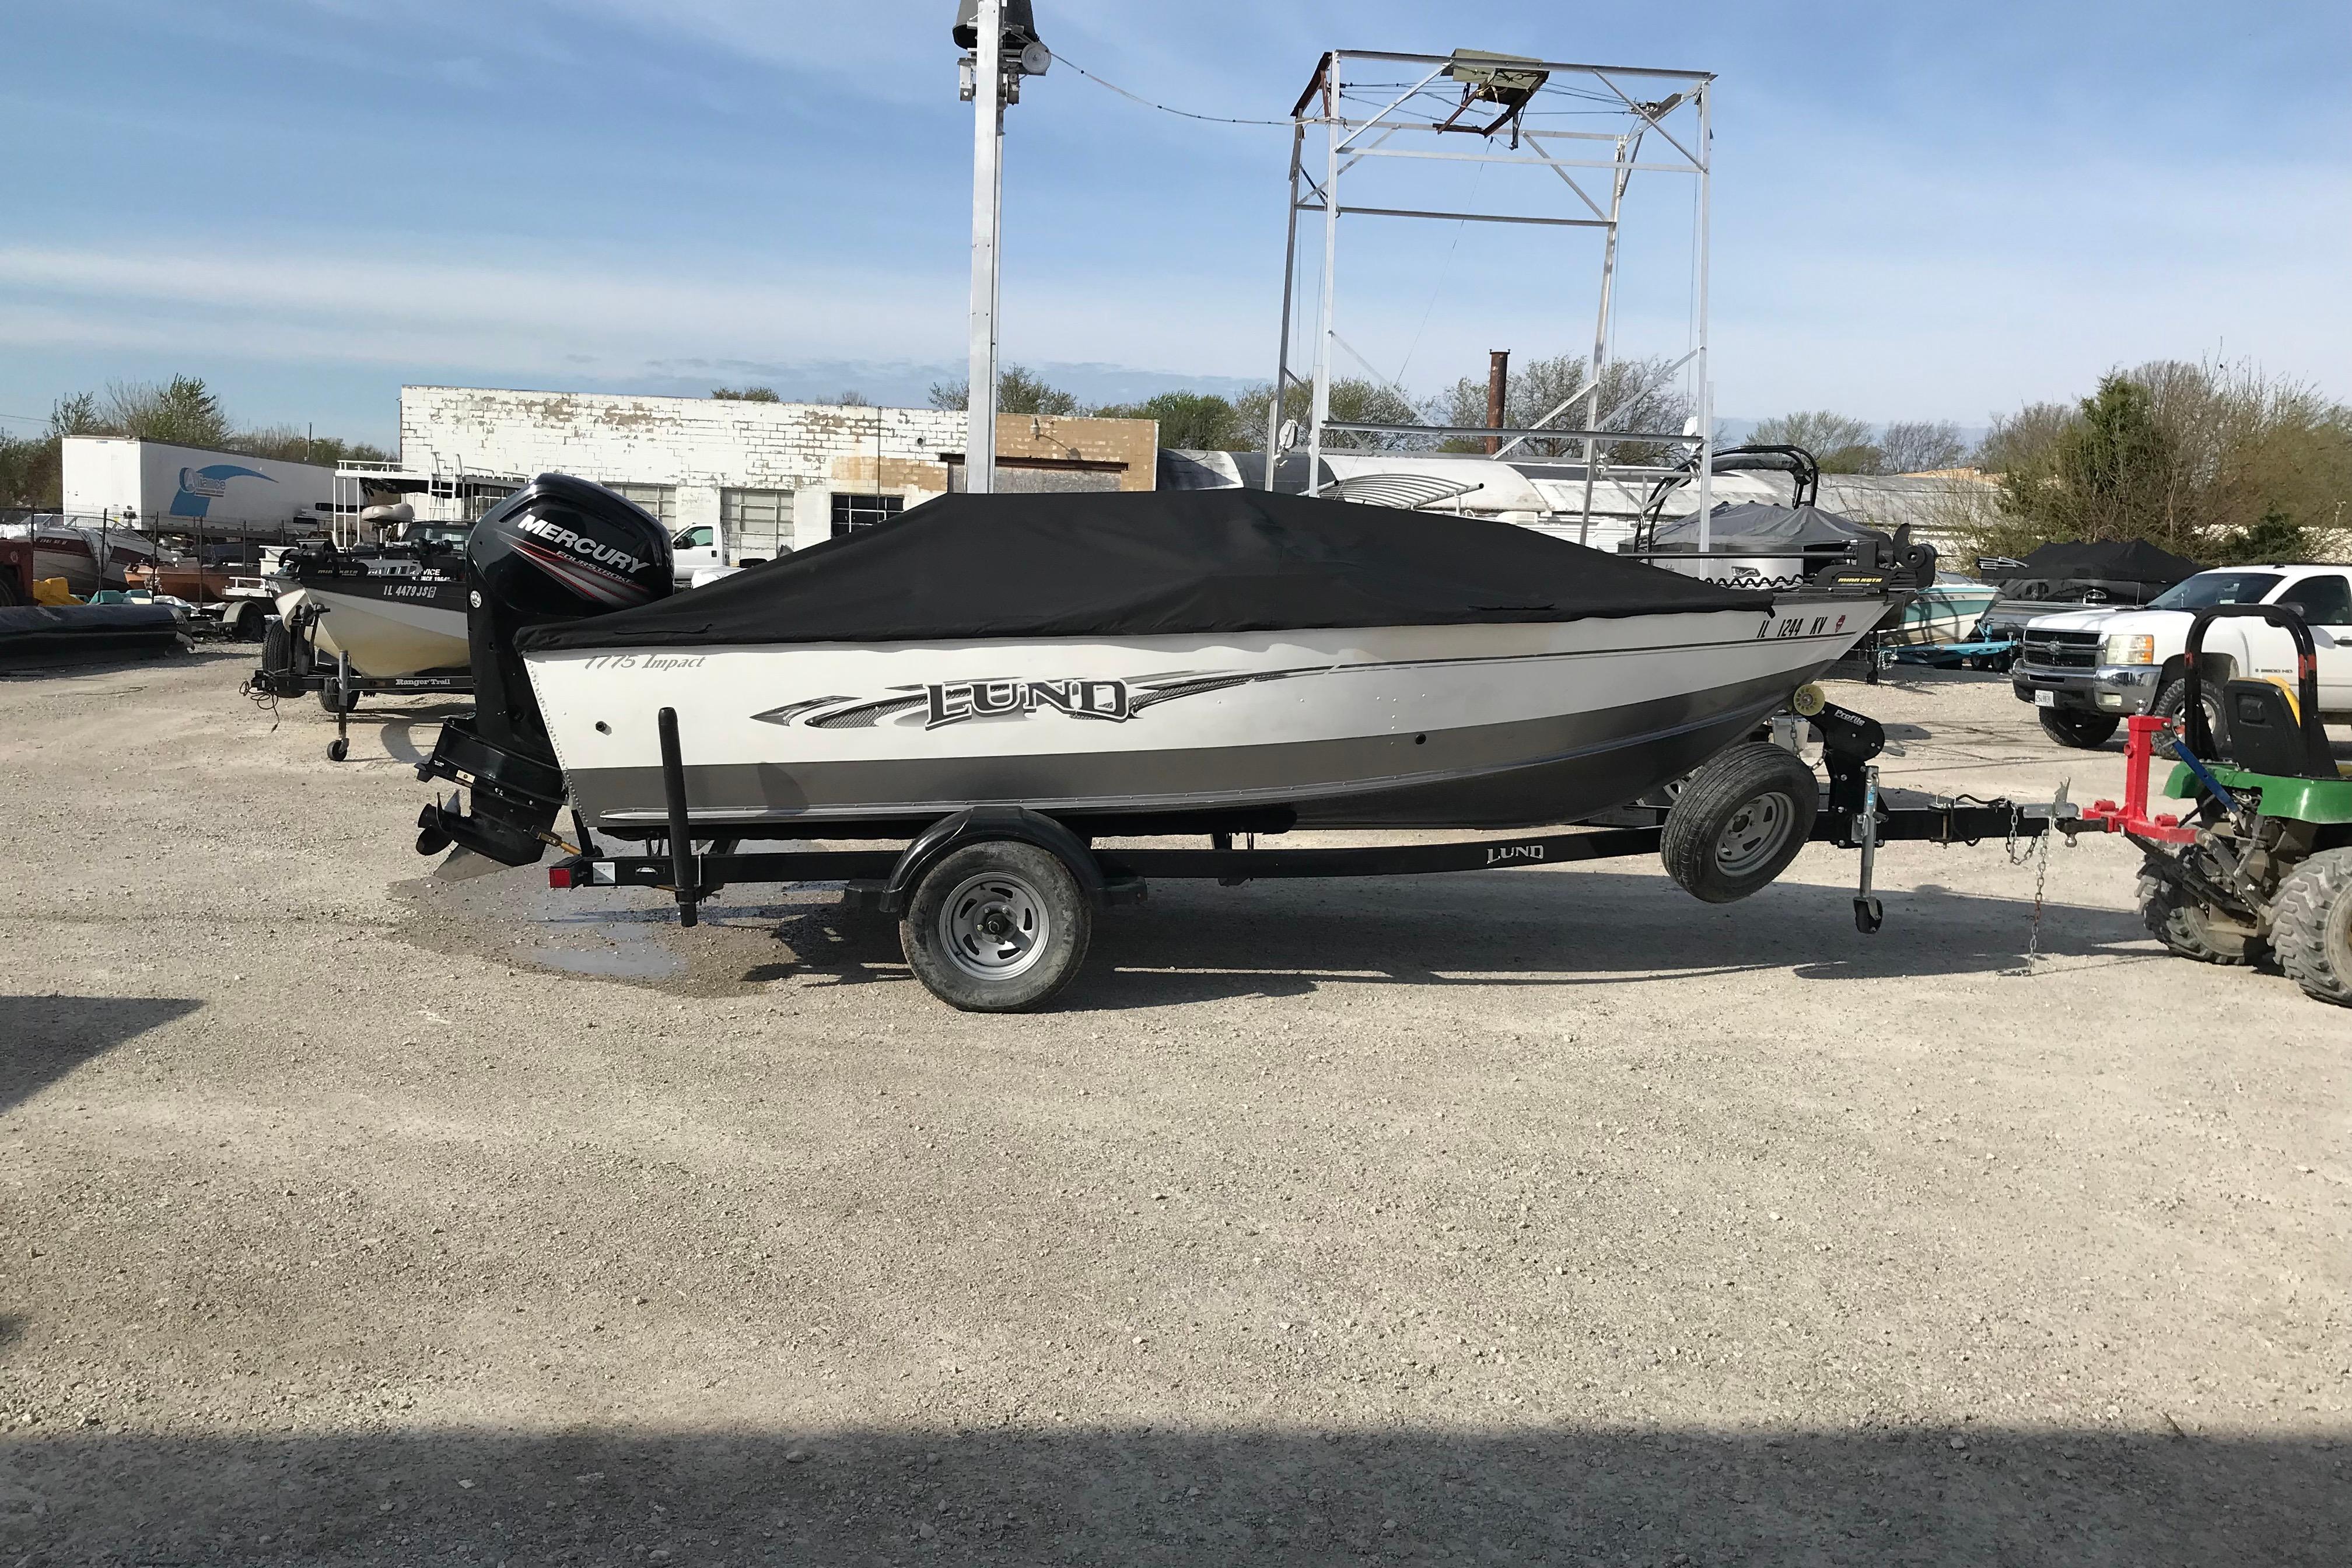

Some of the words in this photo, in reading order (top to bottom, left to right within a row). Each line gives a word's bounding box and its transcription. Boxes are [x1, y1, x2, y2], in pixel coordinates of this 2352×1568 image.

[517, 514, 650, 574] MERCURY
[556, 550, 635, 584] FOURSTROKE
[383, 585, 393, 596] IL
[396, 585, 417, 596] 4479
[416, 586, 429, 597] JS
[1756, 620, 1770, 639] IL
[1776, 618, 1804, 638] 1244
[1809, 617, 1828, 635] KV
[584, 654, 638, 670] 1775
[642, 653, 707, 671] Impact
[396, 678, 429, 687] Ranger
[923, 680, 1129, 731] LUND
[1834, 709, 1866, 725] Profile
[1486, 845, 1544, 864] LUND
